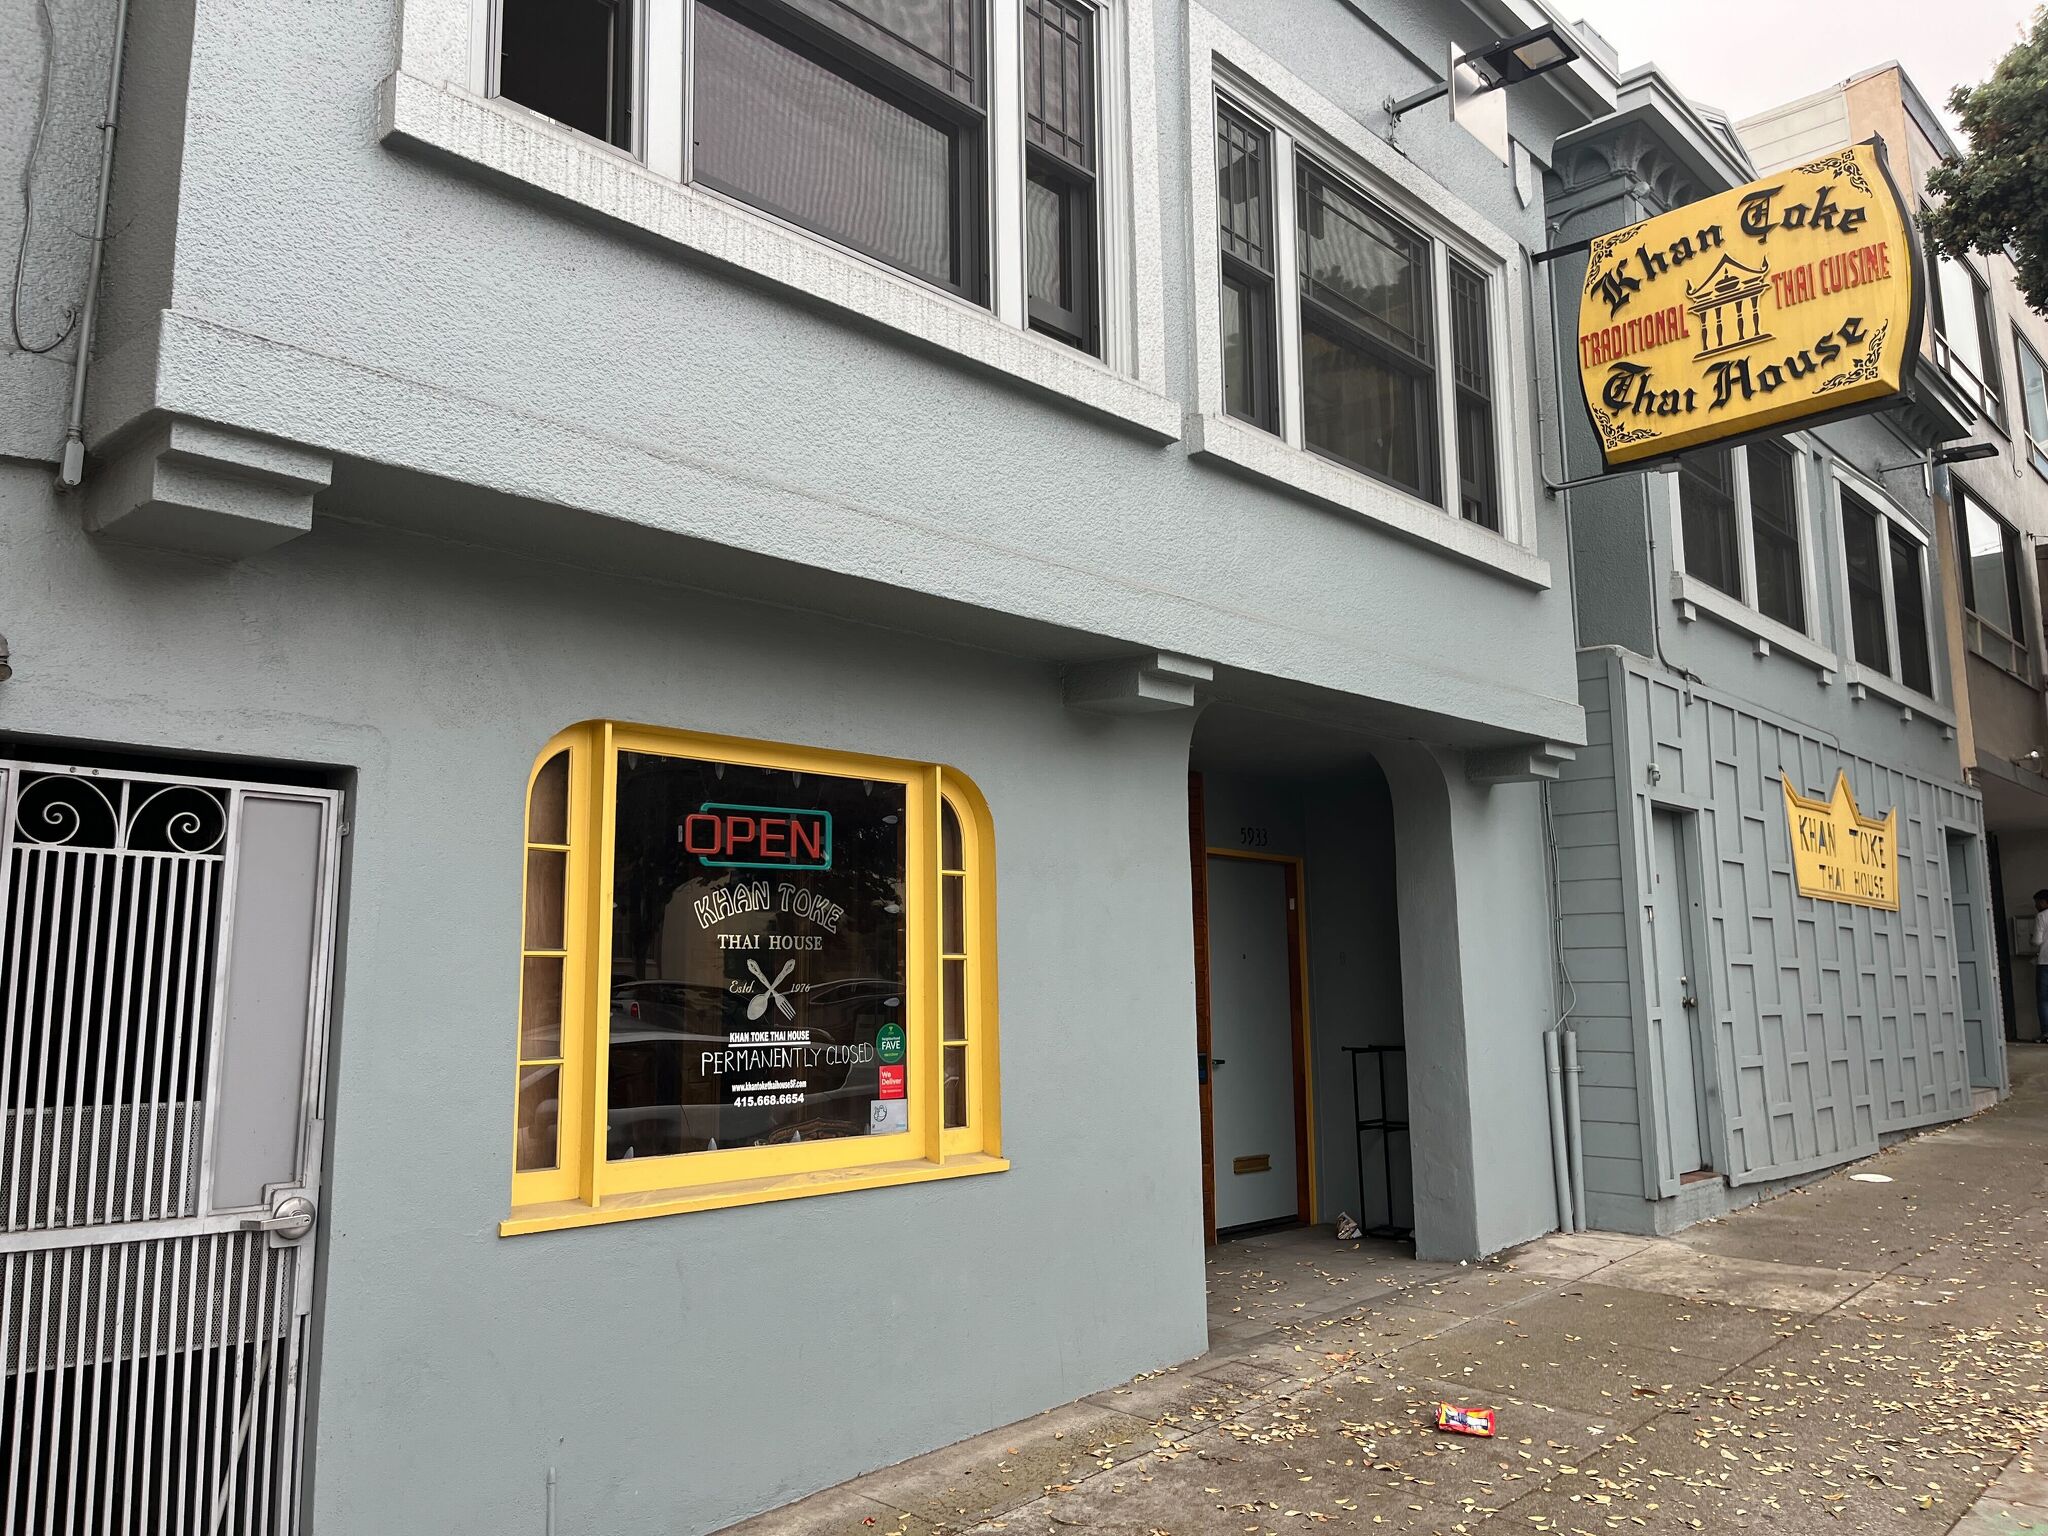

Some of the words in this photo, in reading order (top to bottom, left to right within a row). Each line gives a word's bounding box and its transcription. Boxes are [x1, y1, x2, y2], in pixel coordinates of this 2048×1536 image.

[1590, 223, 1725, 320] Khan
[1737, 184, 1867, 244] Toke
[1771, 265, 1817, 310] THAI
[1819, 241, 1892, 296] CUISINE
[1580, 304, 1690, 369] TRADITIONAL
[1602, 361, 1697, 417] Thai
[1703, 317, 1868, 414] House
[685, 813, 820, 859] OPEN
[1241, 827, 1268, 847] 5933
[1798, 815, 1836, 857] KHAN
[1849, 828, 1886, 868] TOKE
[1819, 864, 1845, 892] THAI
[1854, 871, 1884, 898] HOUSE
[694, 881, 770, 929] KHAN
[778, 882, 844, 934] TOKE
[717, 934, 760, 950] THAI
[769, 935, 823, 951] HOUSE
[790, 983, 811, 993] 1976
[729, 1032, 750, 1043] KHAN
[751, 1031, 769, 1042] TOKE
[770, 1031, 786, 1041] THAI
[787, 1030, 810, 1041] HOUSE
[881, 1040, 901, 1050] FAVE
[701, 1047, 822, 1077] PERMANENTLY
[826, 1042, 874, 1066] CLOSED
[881, 1078, 902, 1086] Deliver
[733, 1093, 804, 1107] 415.668.6654
